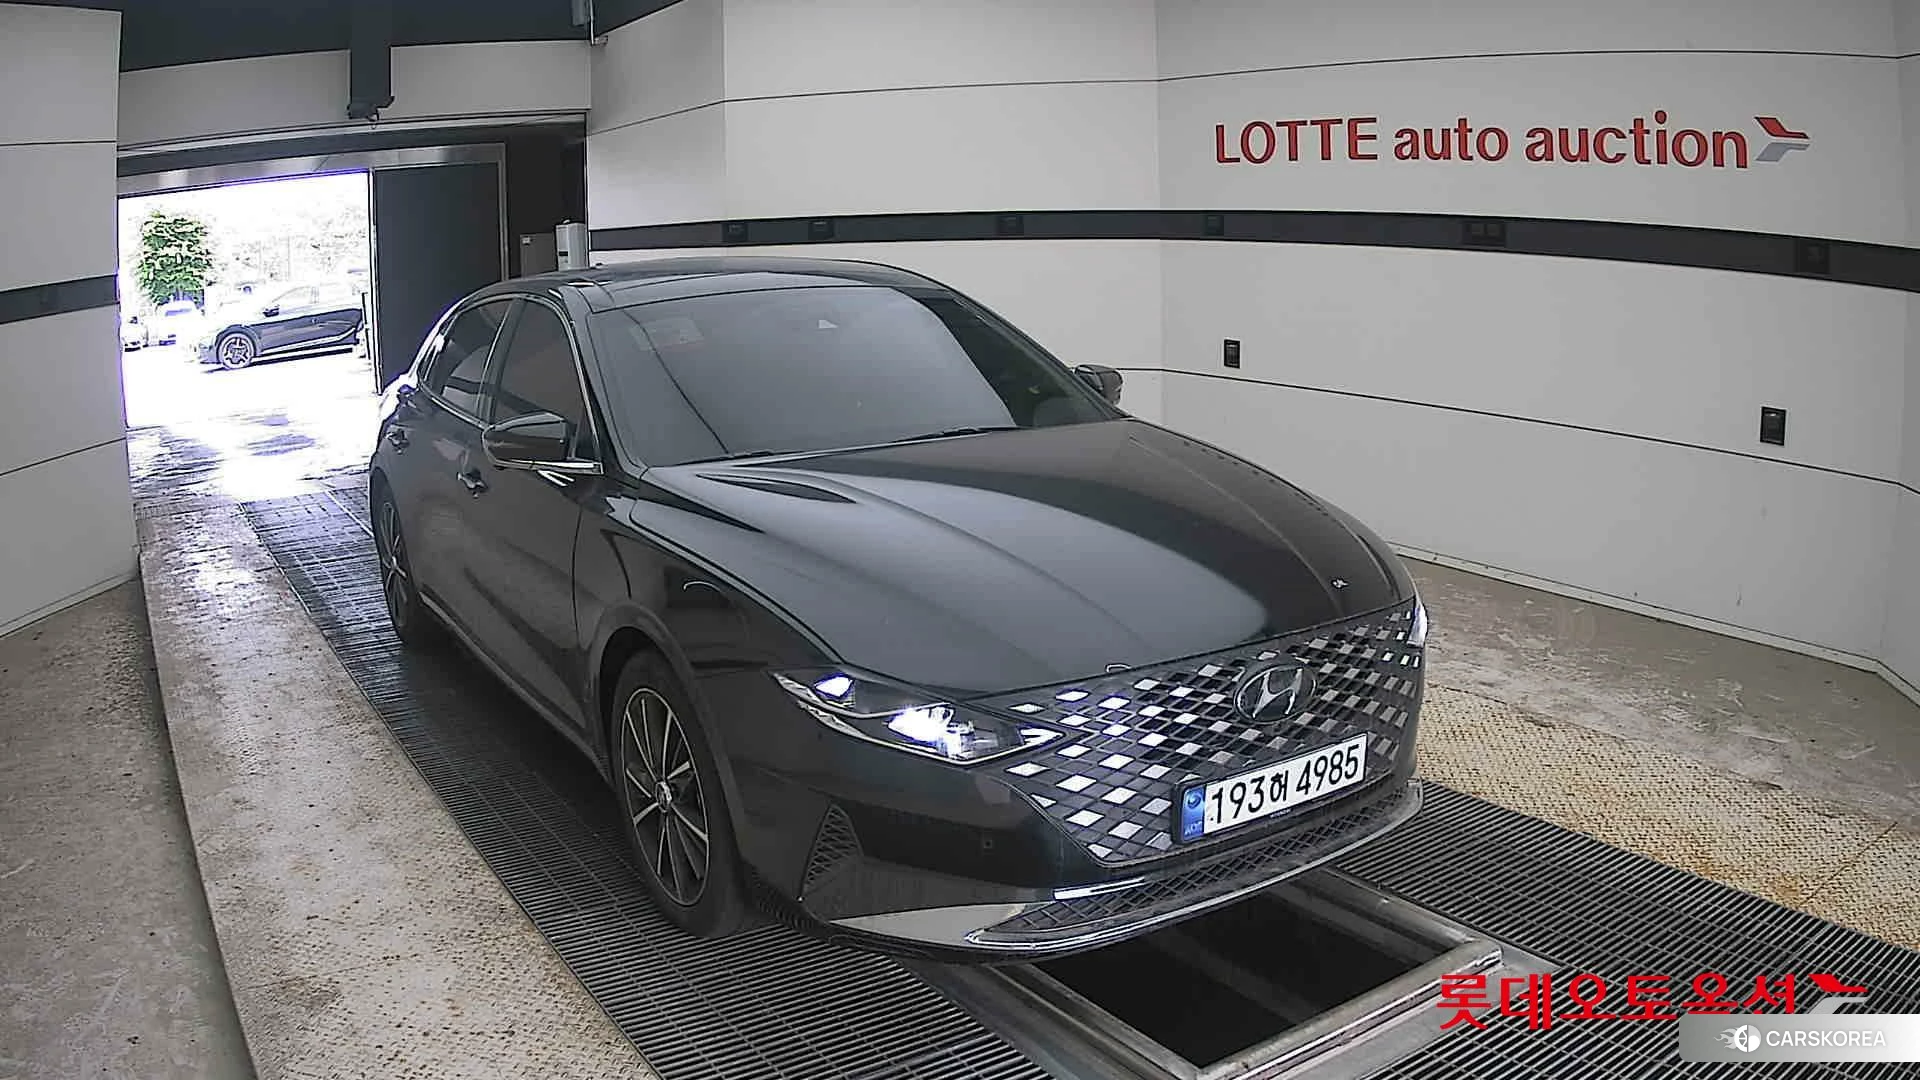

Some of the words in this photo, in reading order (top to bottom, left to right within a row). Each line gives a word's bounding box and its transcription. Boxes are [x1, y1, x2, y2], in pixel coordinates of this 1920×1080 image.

[1215, 117, 1378, 163] LOTTE
[1394, 117, 1509, 162] auto
[1525, 110, 1749, 169] auction
[1211, 769, 1289, 824] 193허
[1296, 743, 1360, 796] 4985
